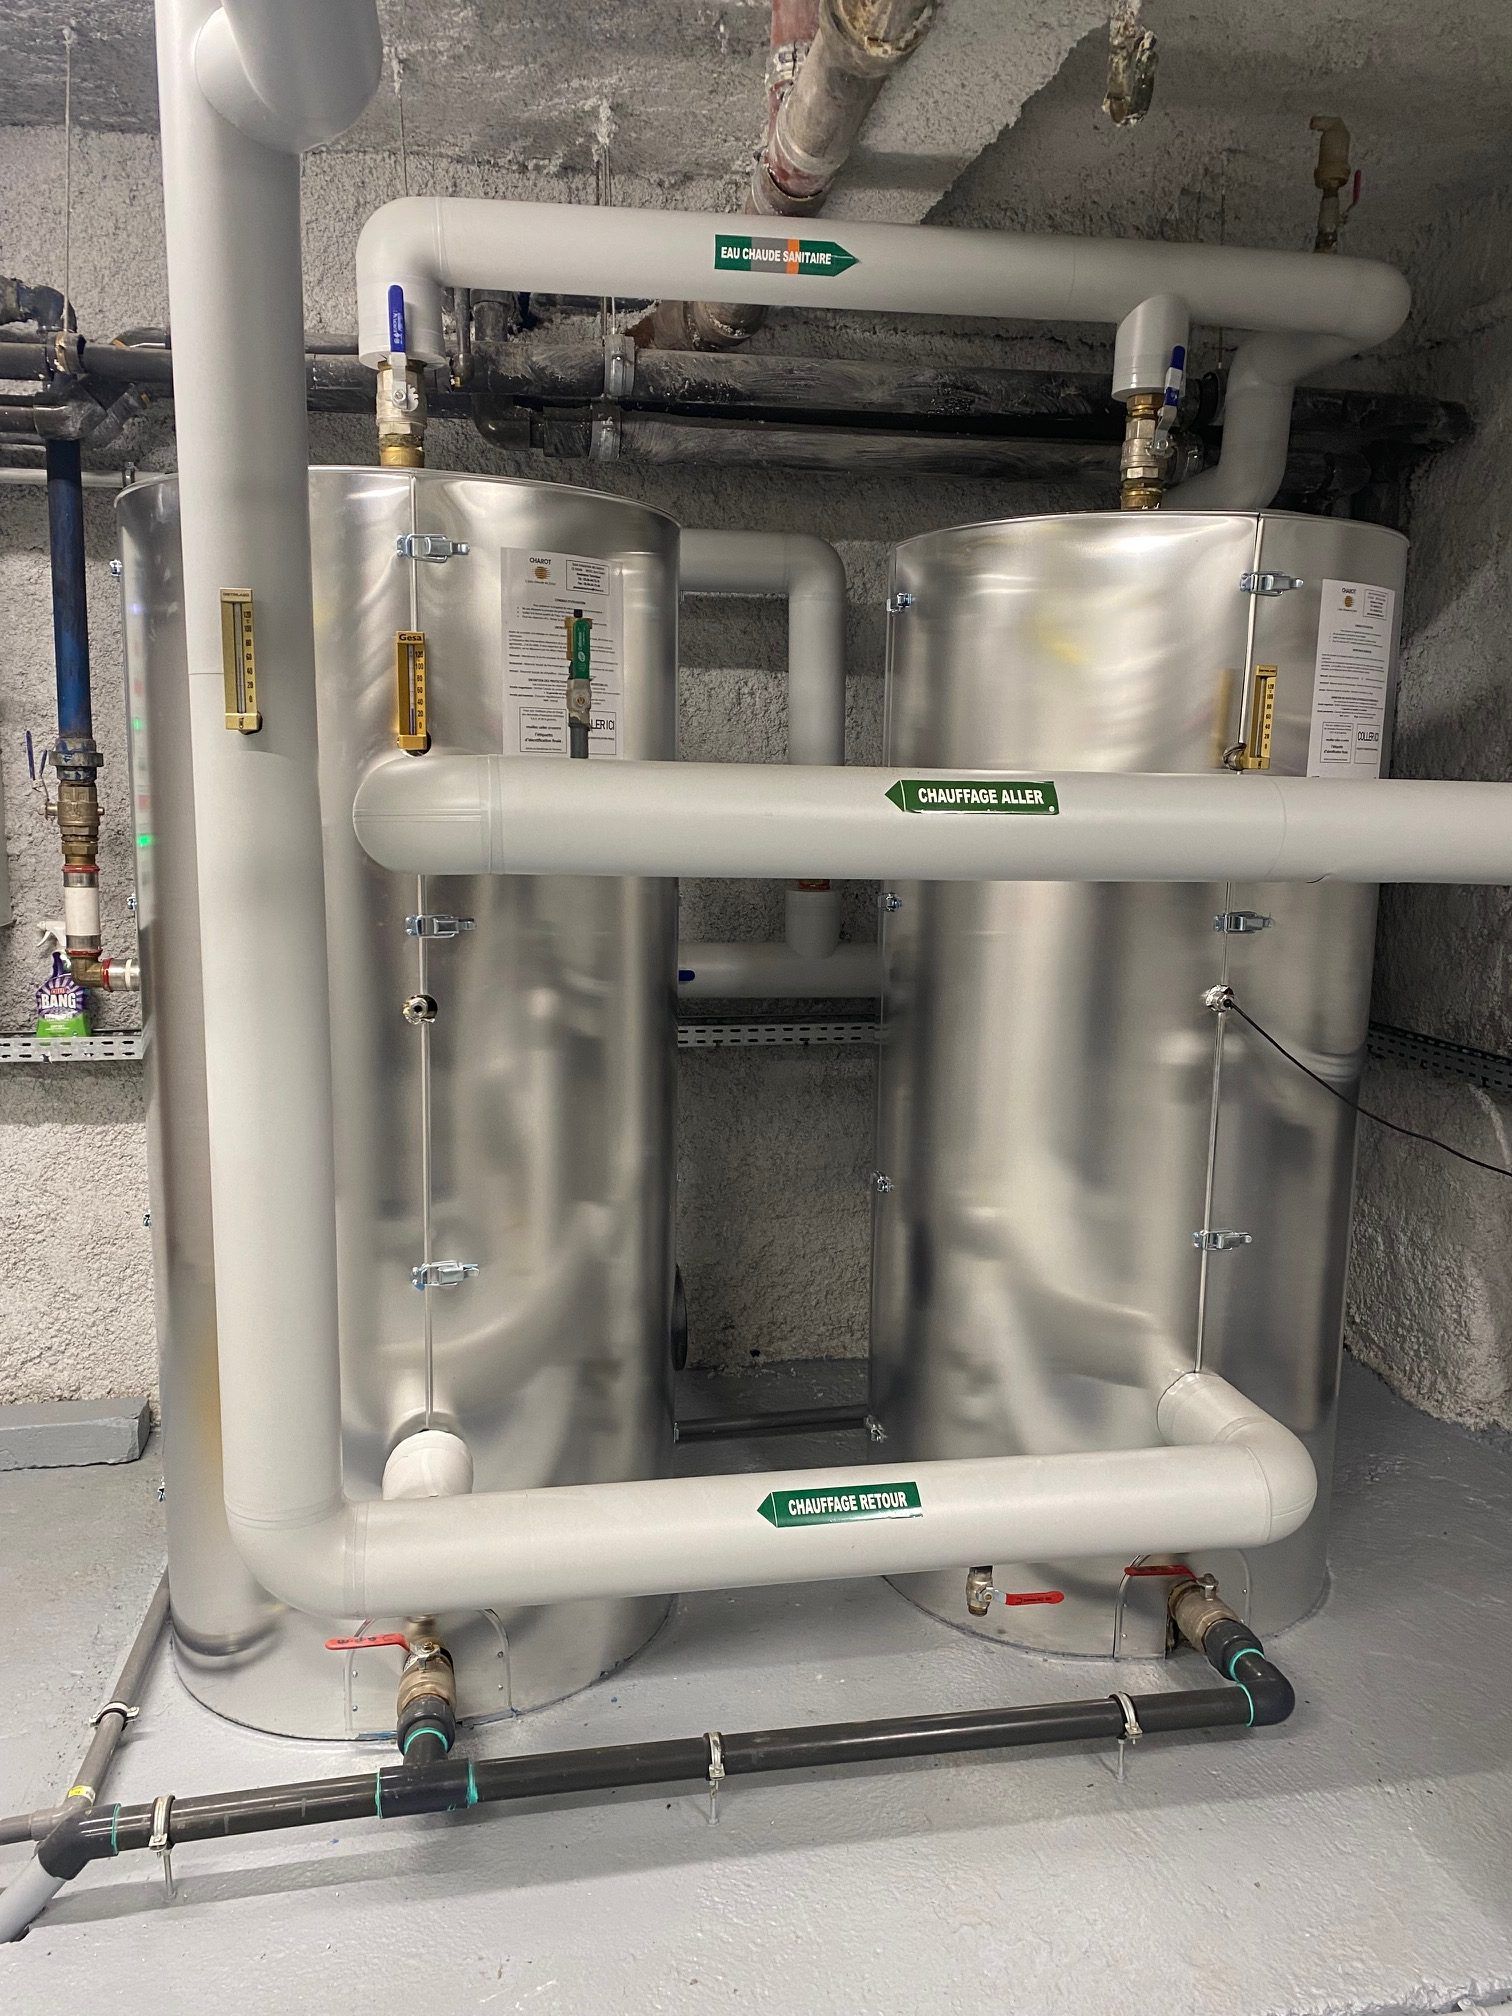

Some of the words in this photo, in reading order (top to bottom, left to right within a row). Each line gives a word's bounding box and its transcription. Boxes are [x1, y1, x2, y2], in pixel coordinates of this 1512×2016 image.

[721, 246, 741, 260] EAU
[742, 247, 781, 262] CHAUDE
[782, 250, 832, 265] SANITAIRE
[529, 557, 551, 565] CHAROT
[399, 633, 423, 641] Gesa
[247, 667, 253, 675] 40
[591, 719, 605, 731] LER
[605, 720, 615, 730] ICI
[917, 787, 998, 804] CHAUFFAGE
[1001, 789, 1044, 805] ALLER
[41, 993, 77, 1009] BANG
[788, 1494, 858, 1516] CHAUFFAGE
[859, 1491, 908, 1510] RETOUR
